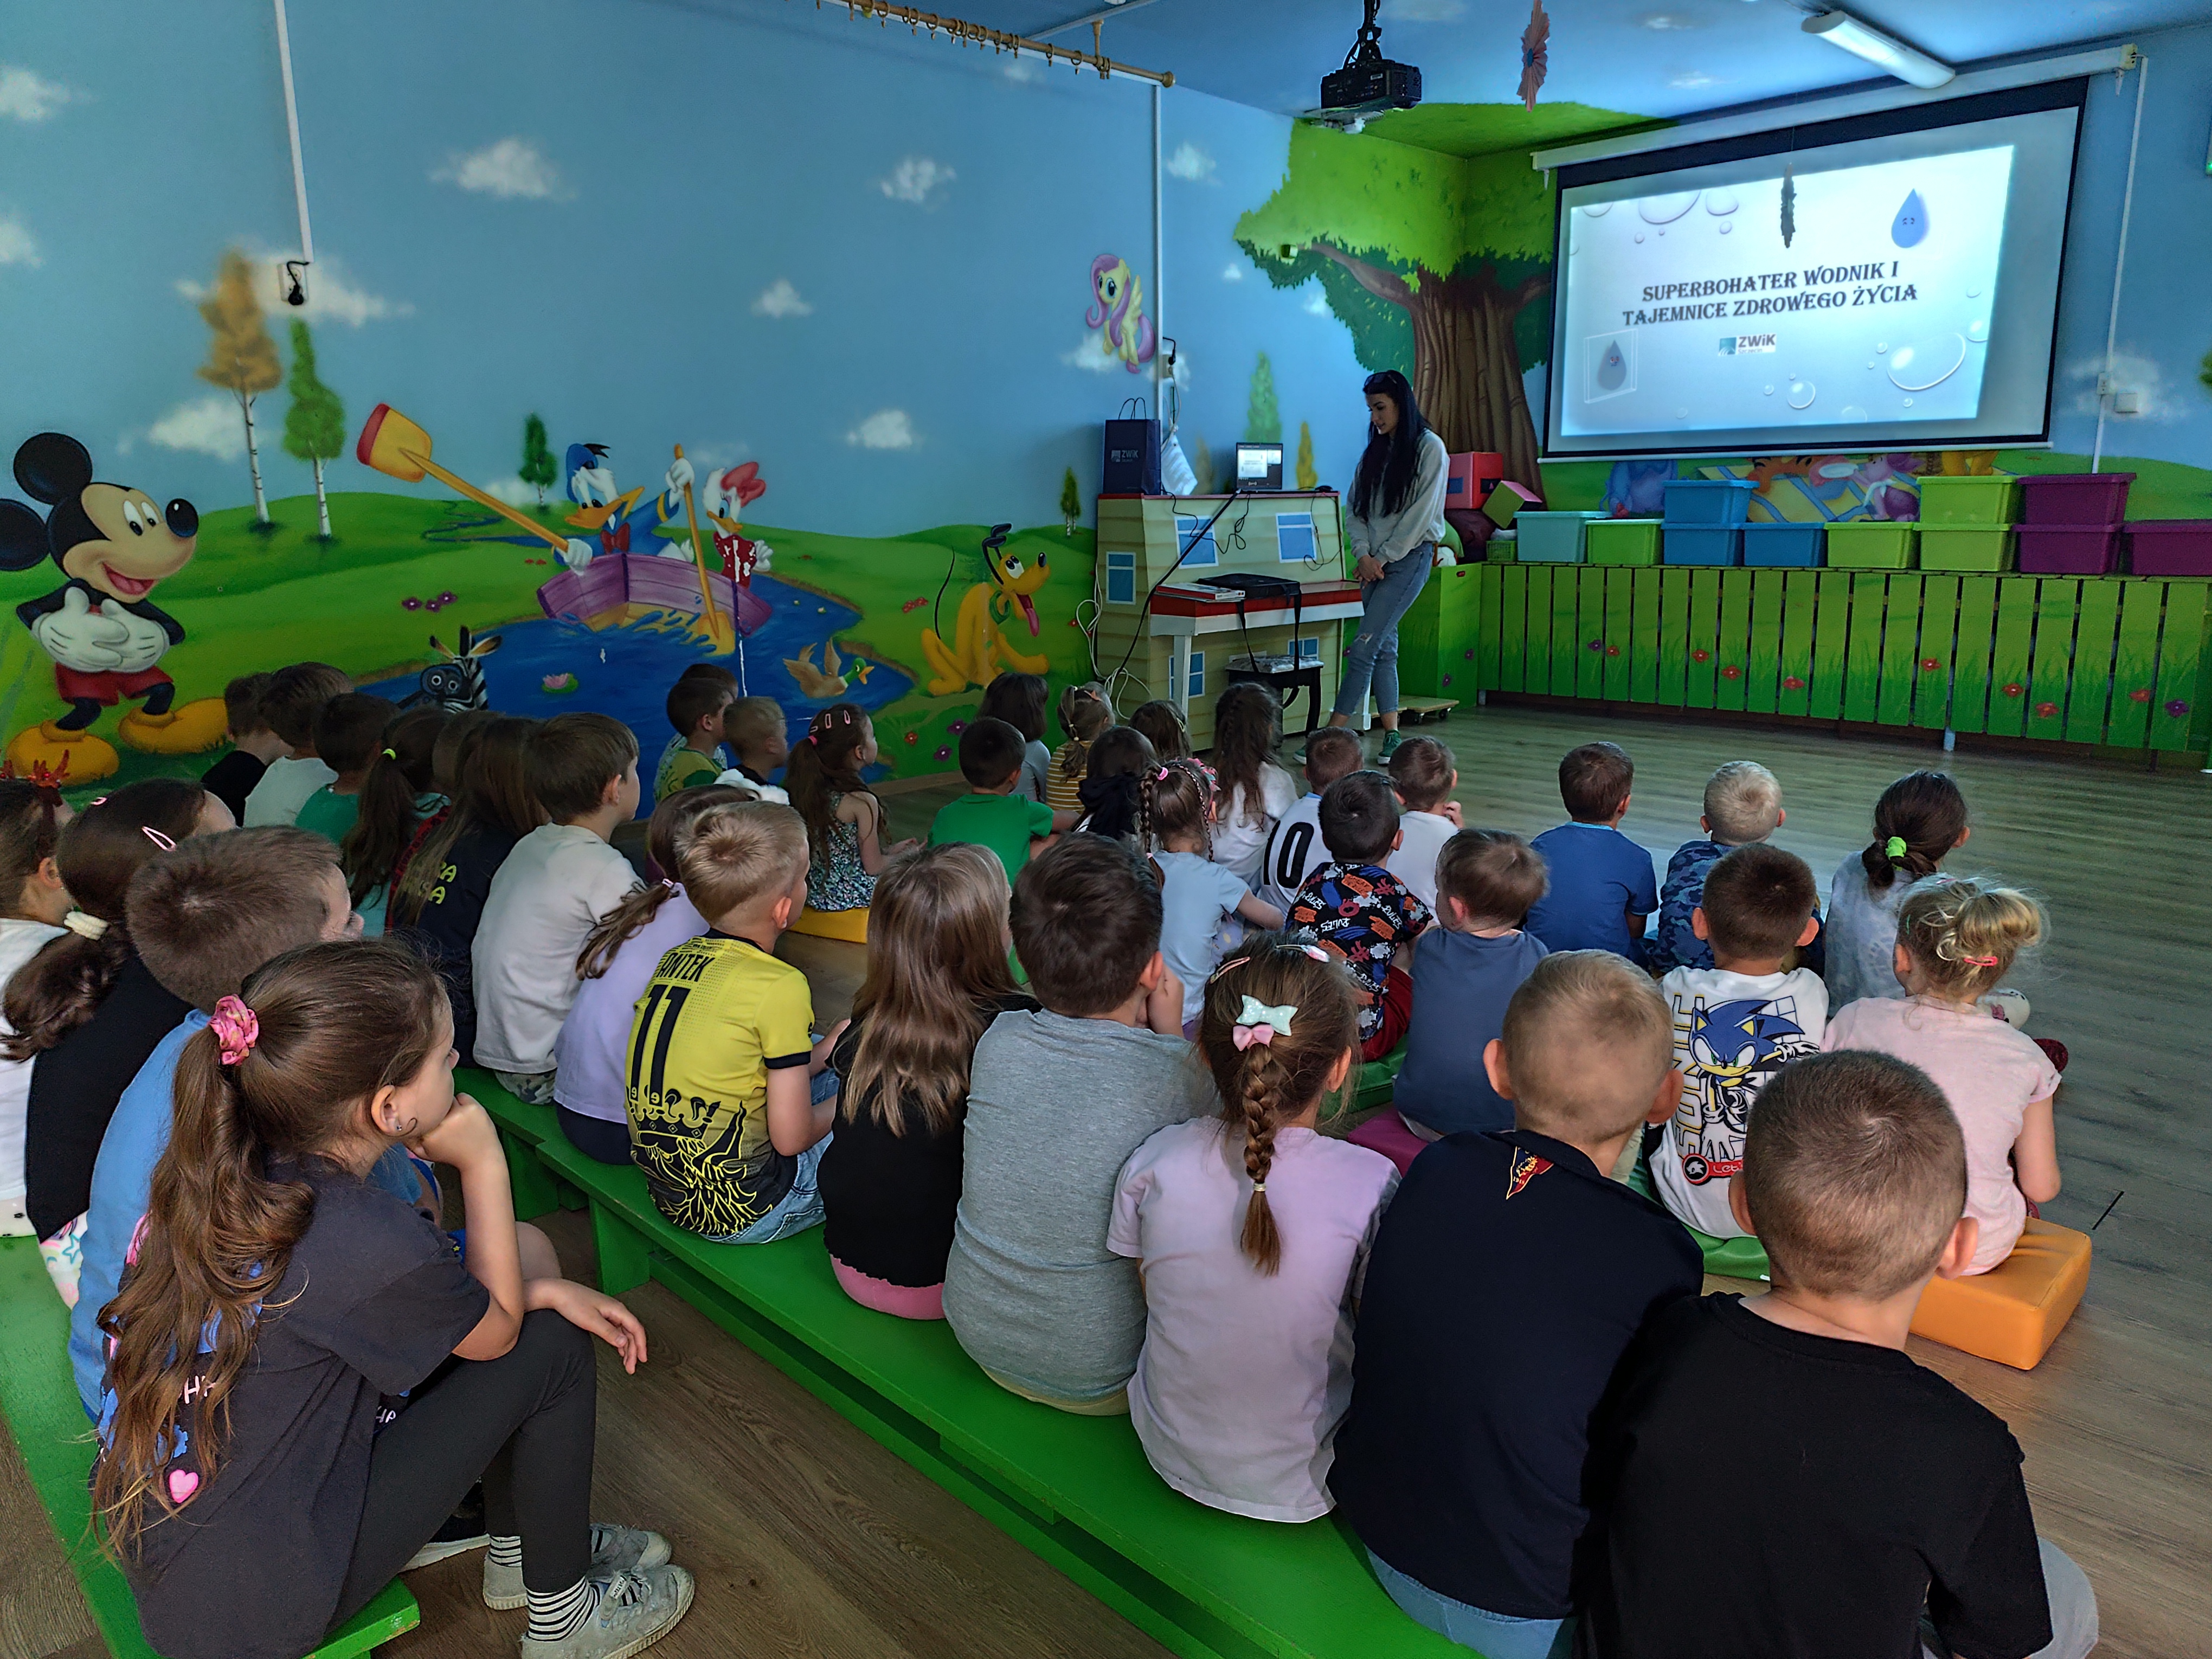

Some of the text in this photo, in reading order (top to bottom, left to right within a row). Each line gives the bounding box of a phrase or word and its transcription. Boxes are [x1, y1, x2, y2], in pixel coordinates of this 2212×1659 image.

[1642, 261, 1899, 302] SUPERBOHATER WODNIK I
[1623, 284, 1918, 326] TAJEMNICE ZDROWEGO ŻYCIA
[1738, 334, 1776, 348] ZWiK
[1263, 820, 1315, 889] 10
[656, 953, 716, 982] ANTEK
[630, 985, 691, 1107] 11
